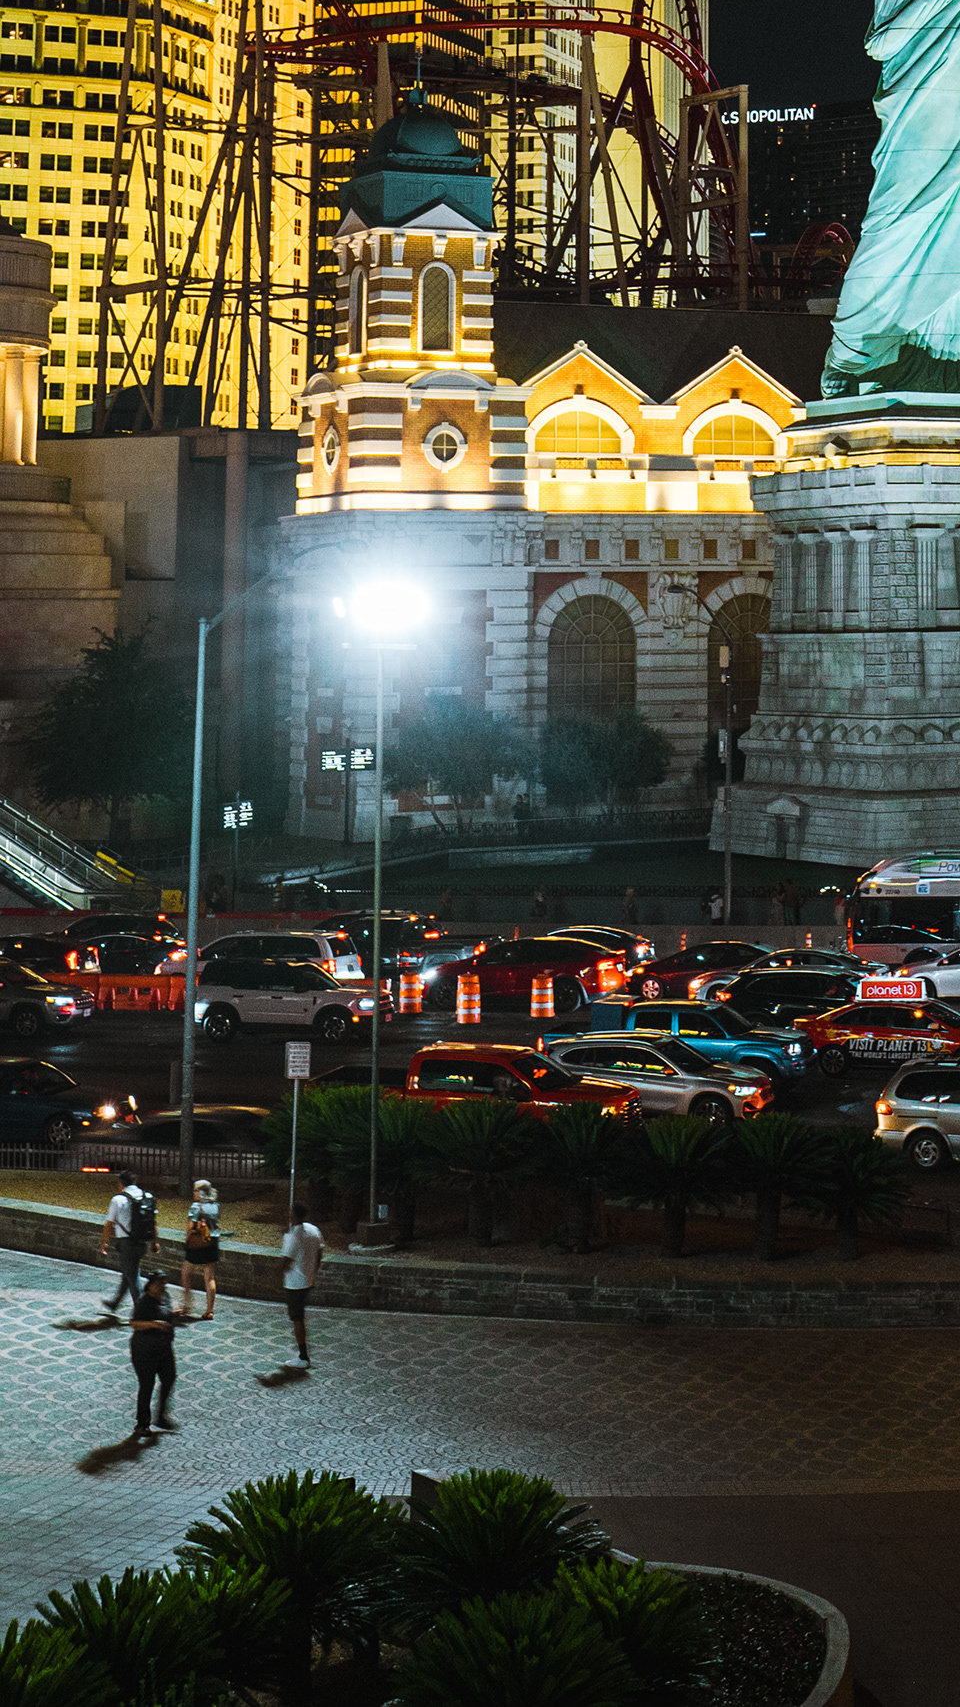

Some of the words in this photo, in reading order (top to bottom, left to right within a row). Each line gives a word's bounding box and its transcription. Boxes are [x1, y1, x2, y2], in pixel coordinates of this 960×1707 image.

[866, 984, 902, 998] planet
[903, 984, 914, 995] 13
[849, 1038, 875, 1050] VISIT
[876, 1039, 915, 1052] PLANET
[916, 1040, 927, 1052] 13
